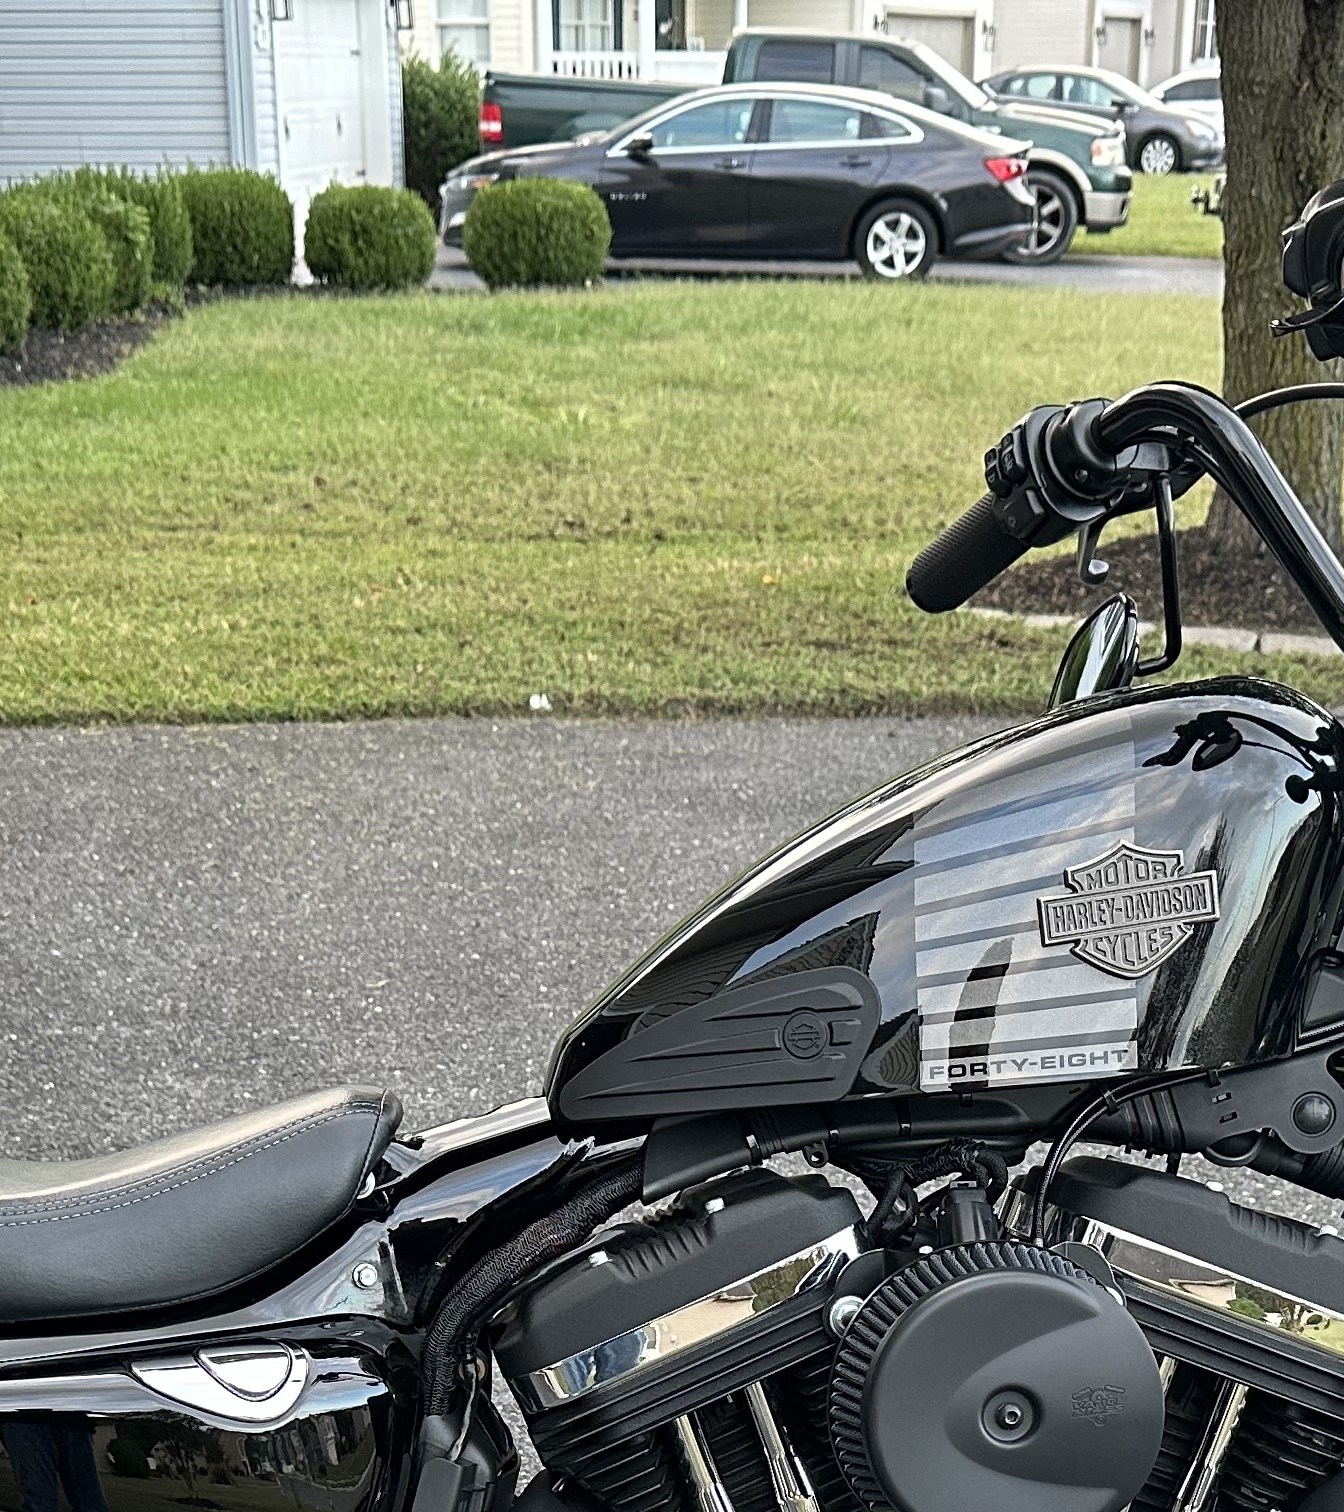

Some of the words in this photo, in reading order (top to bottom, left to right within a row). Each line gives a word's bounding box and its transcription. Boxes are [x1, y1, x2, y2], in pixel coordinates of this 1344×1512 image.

[1086, 853, 1167, 890] MOTOR
[1050, 882, 1207, 934] HARLEY-DAVIDSON
[1093, 925, 1173, 967] CYCLES
[929, 1049, 1129, 1081] FORTY-EIGHT
